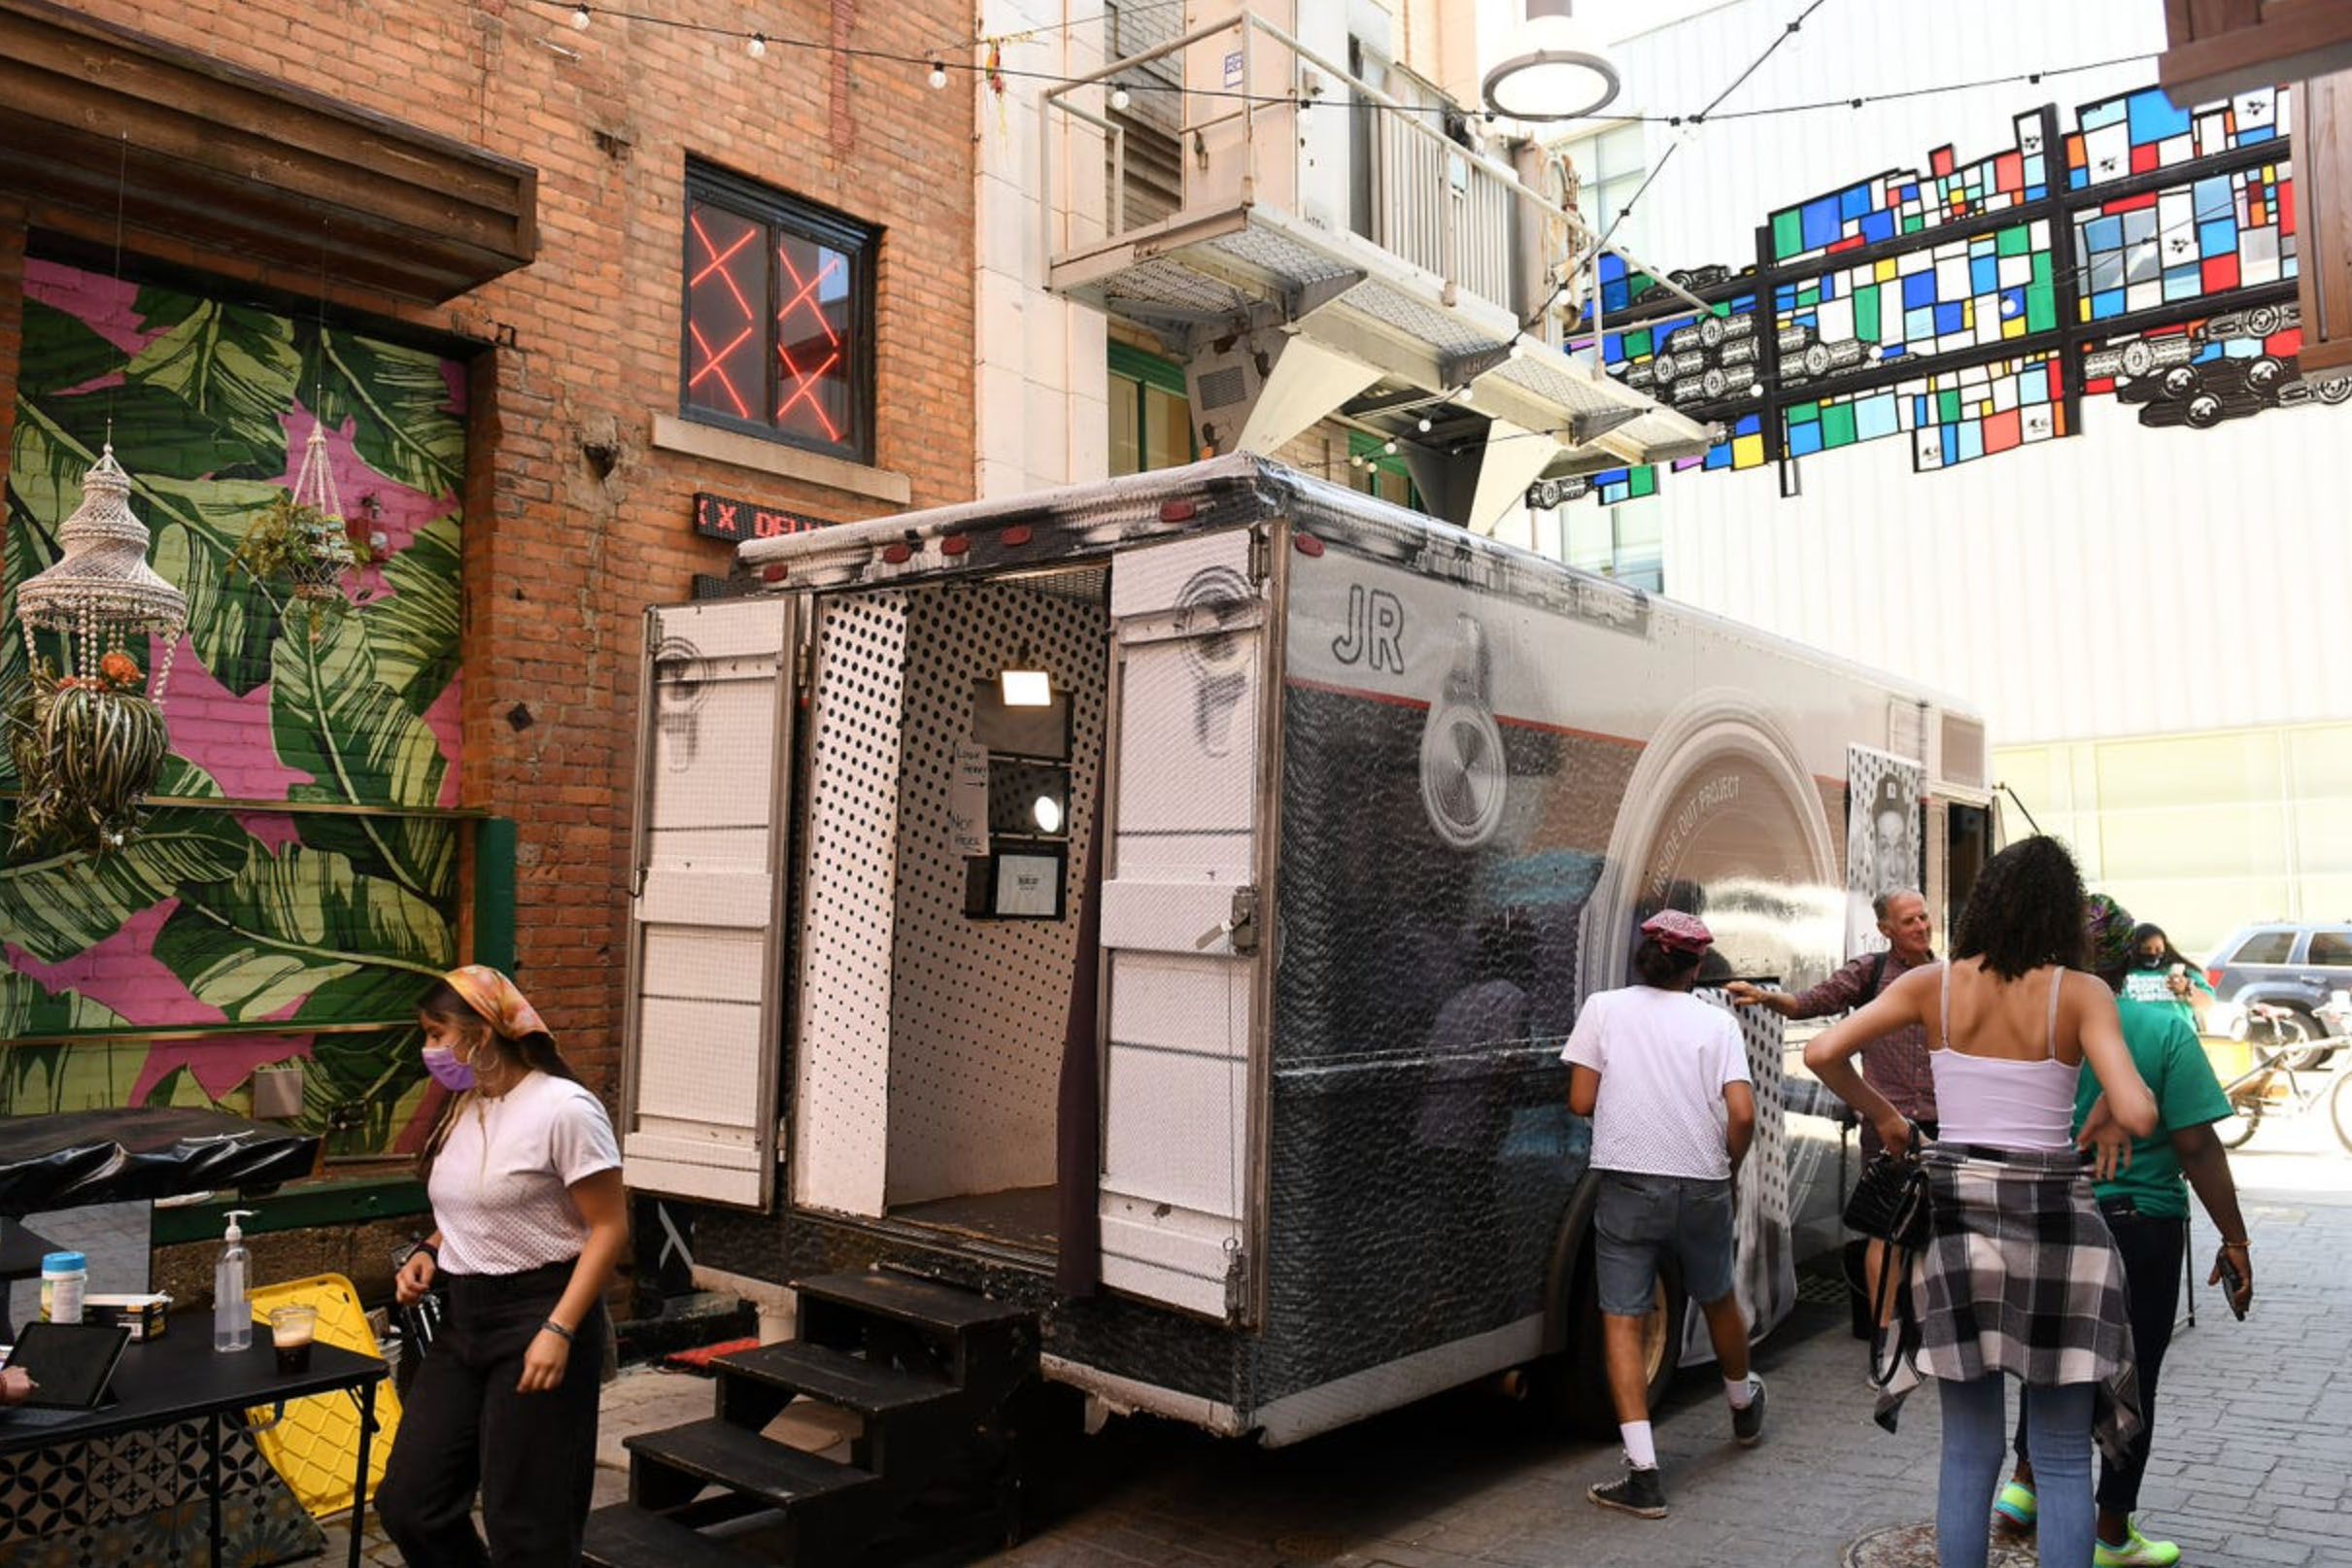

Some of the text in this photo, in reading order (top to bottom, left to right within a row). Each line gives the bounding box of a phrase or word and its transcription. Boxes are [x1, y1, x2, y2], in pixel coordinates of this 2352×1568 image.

[1332, 583, 1405, 675] JR
[1652, 775, 1741, 898] INSIDE OUT PROJECT
